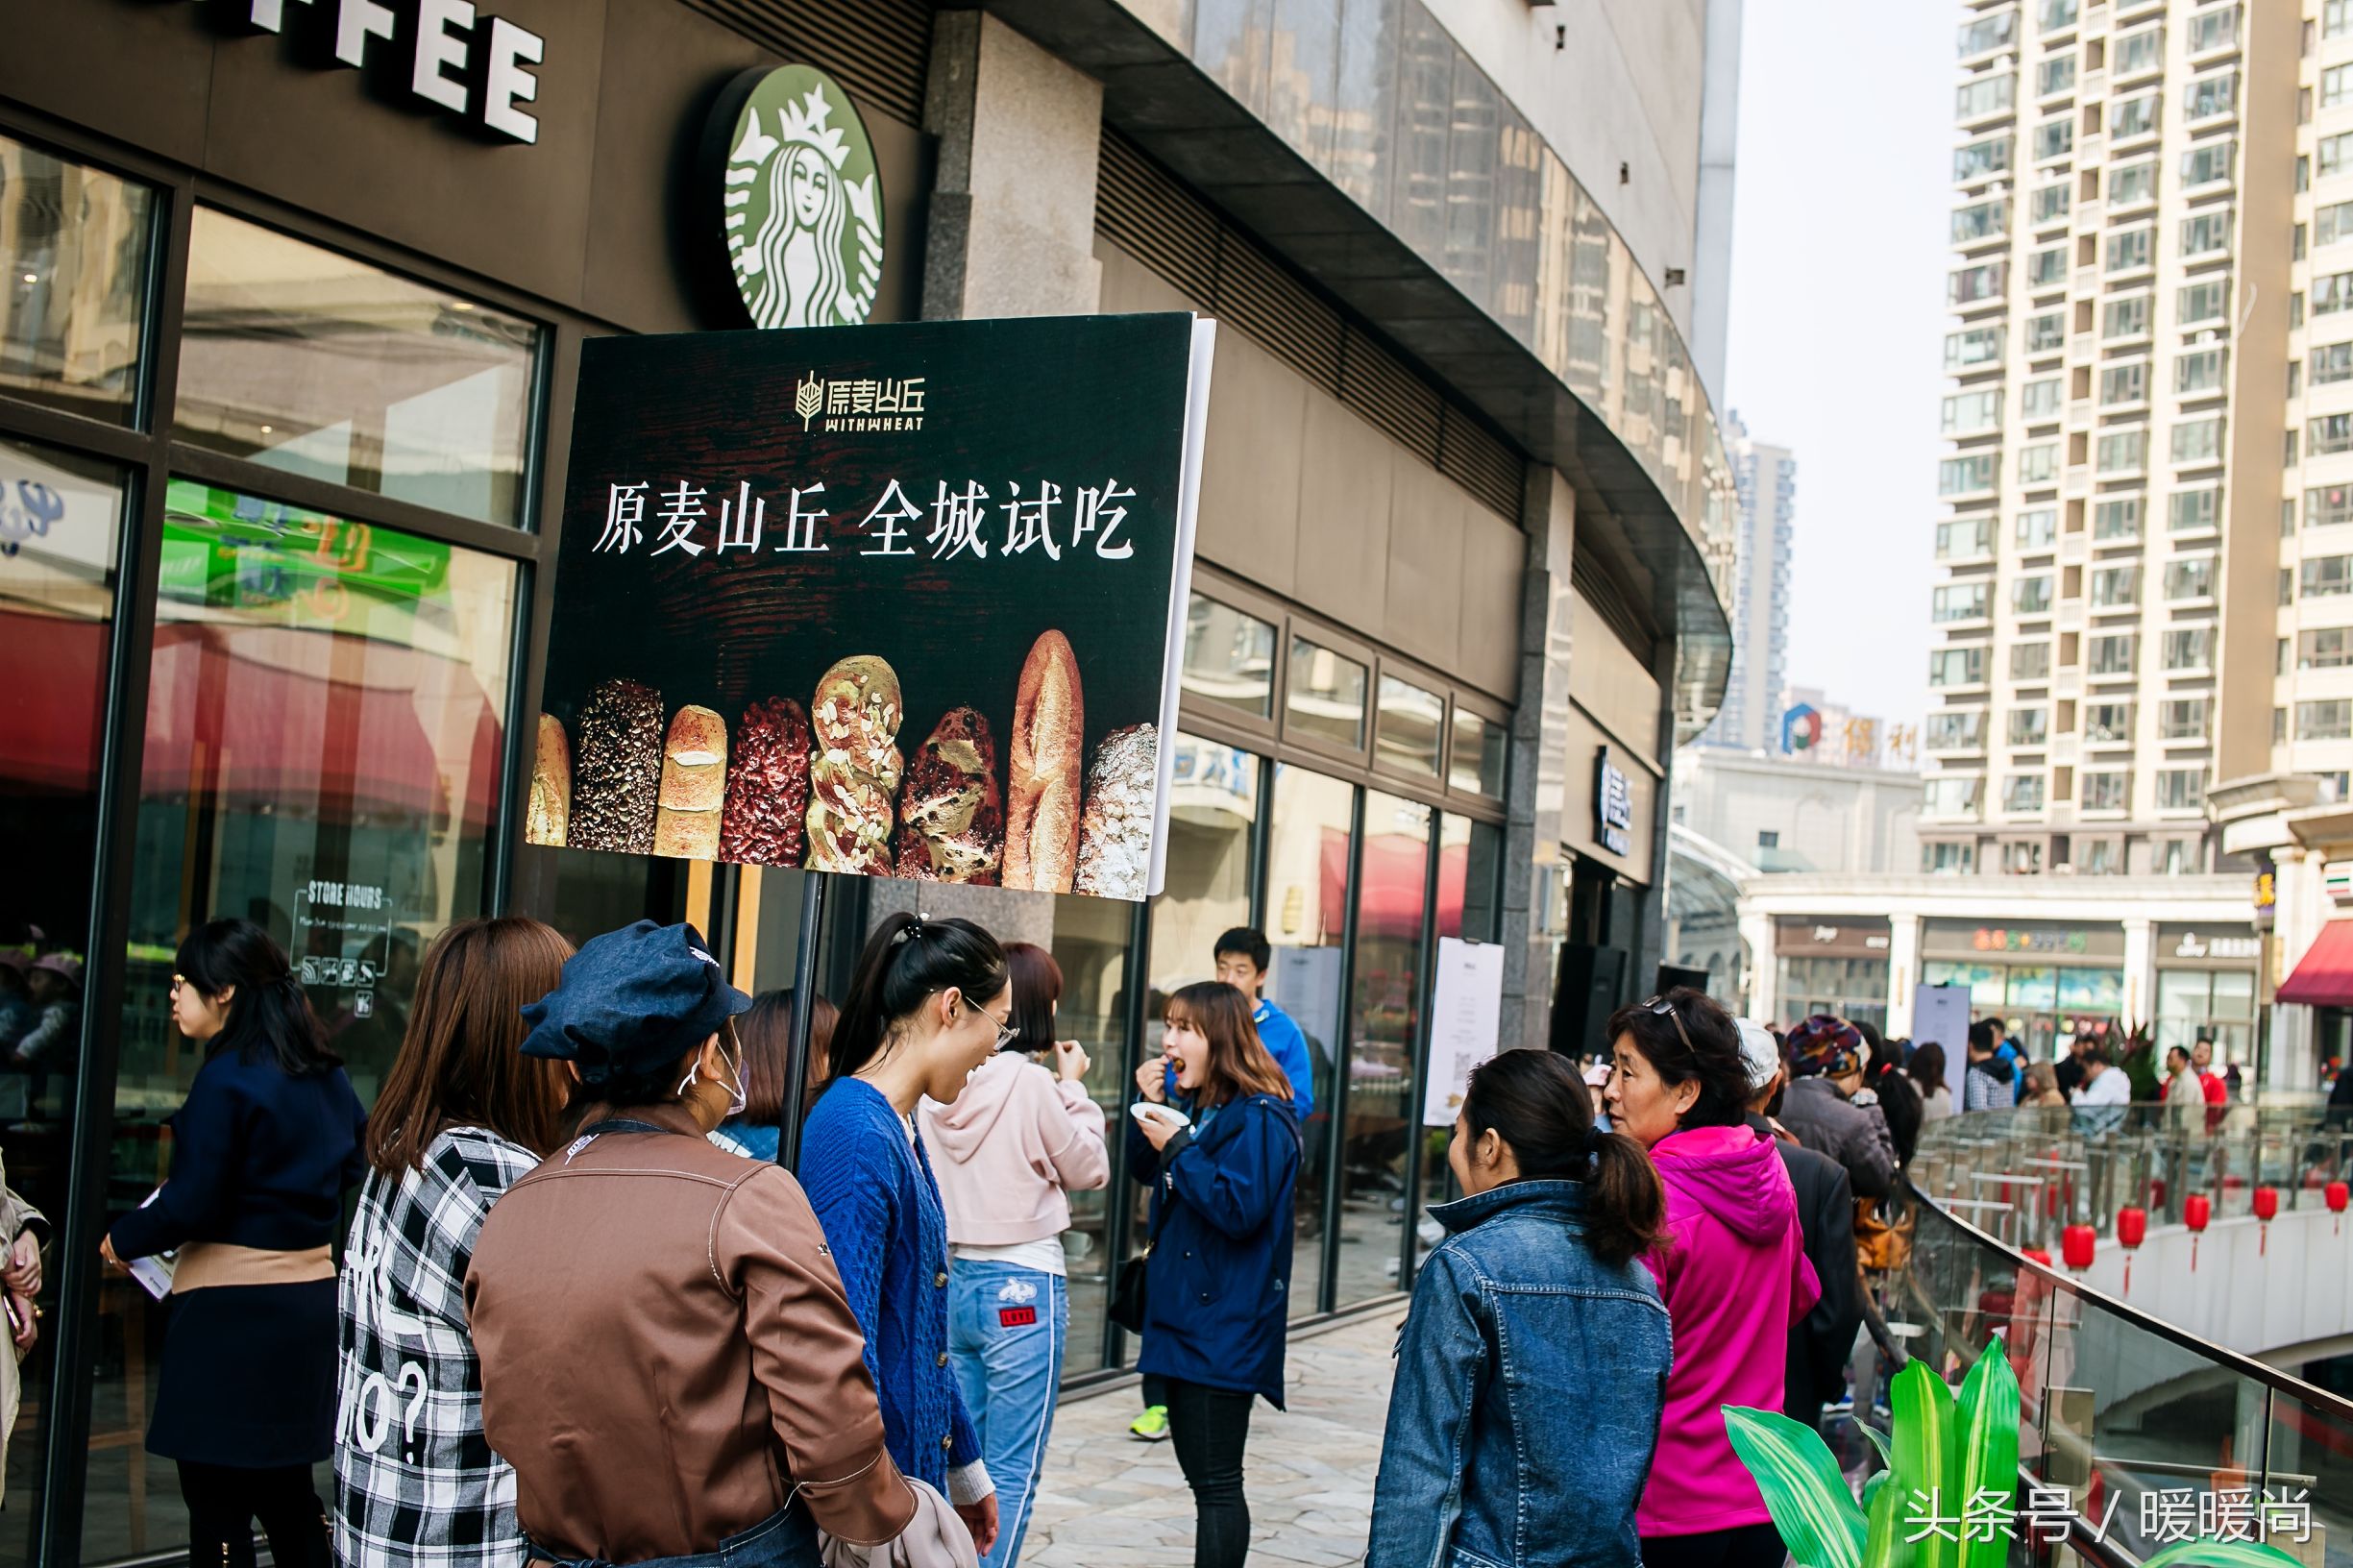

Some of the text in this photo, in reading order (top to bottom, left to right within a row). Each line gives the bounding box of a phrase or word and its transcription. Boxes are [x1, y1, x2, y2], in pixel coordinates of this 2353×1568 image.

[192, 0, 544, 144] FEE
[826, 378, 925, 415] 原麦山丘
[825, 417, 923, 432] WITHWHEAT
[592, 478, 1137, 561] 原麦山丘 全城试吃
[307, 880, 382, 910] STORE HOURS
